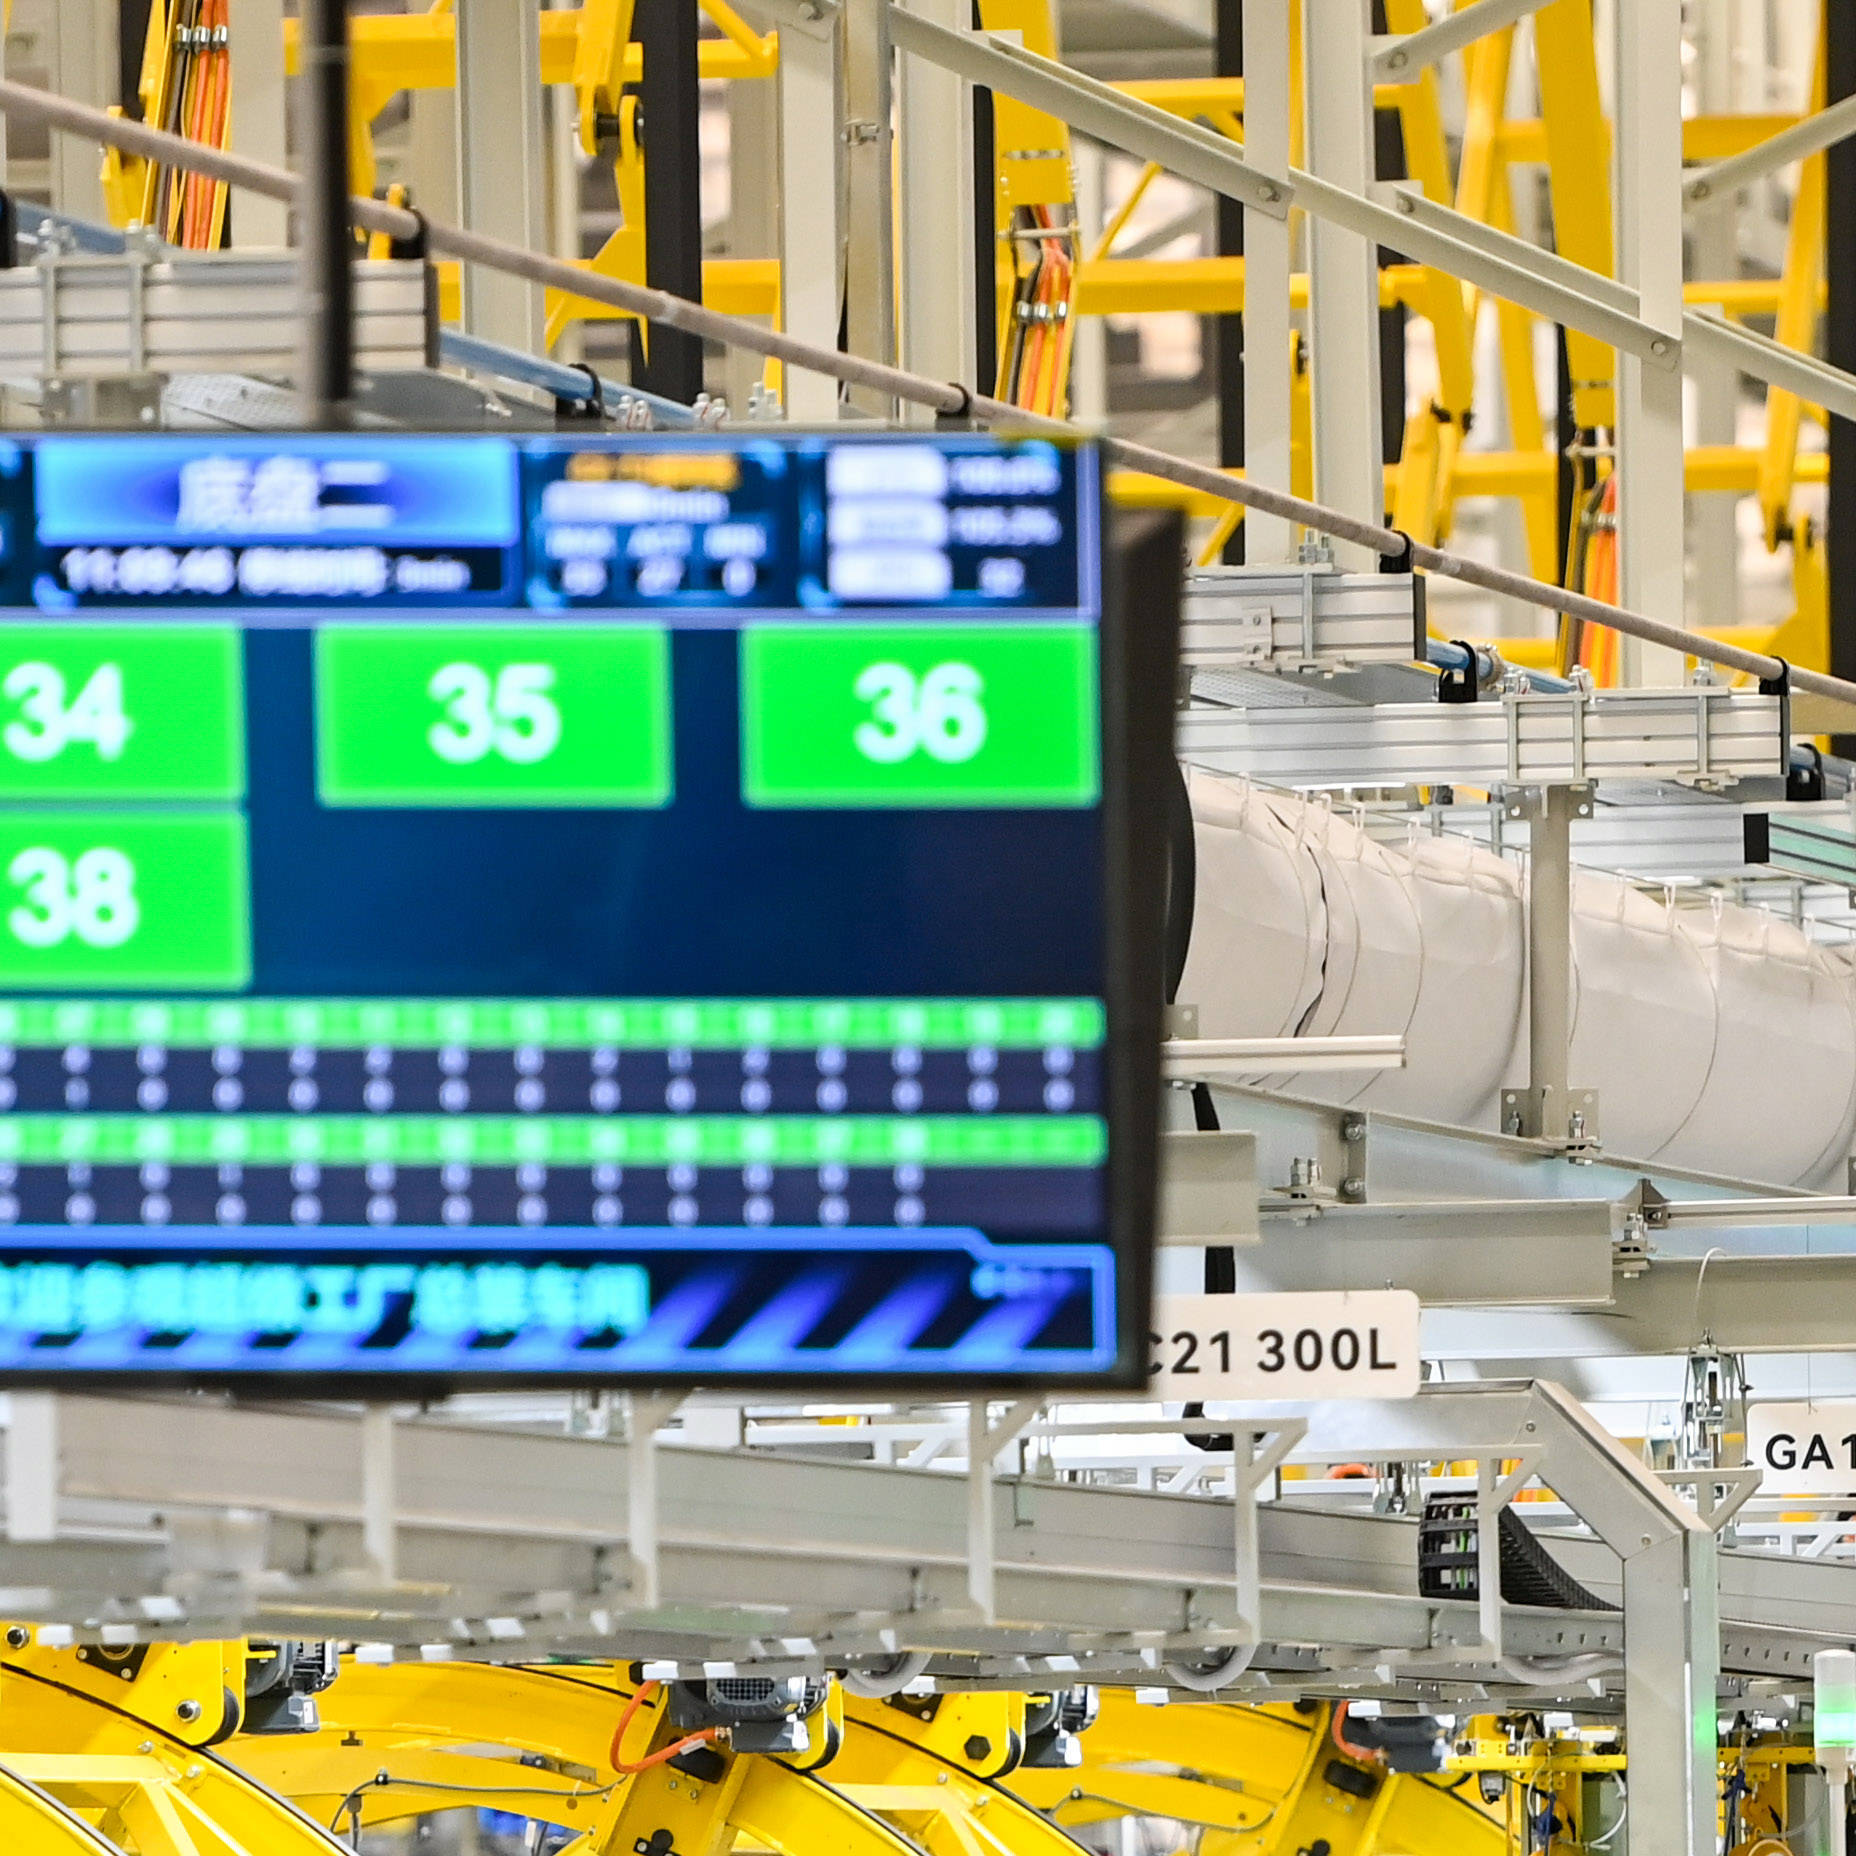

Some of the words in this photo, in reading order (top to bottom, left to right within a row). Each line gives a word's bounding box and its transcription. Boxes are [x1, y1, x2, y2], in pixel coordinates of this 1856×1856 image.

[2, 662, 133, 762] 34
[426, 662, 561, 764] 35
[853, 662, 986, 764] 36
[7, 846, 139, 946] 38
[1257, 1328, 1397, 1373] 300L
